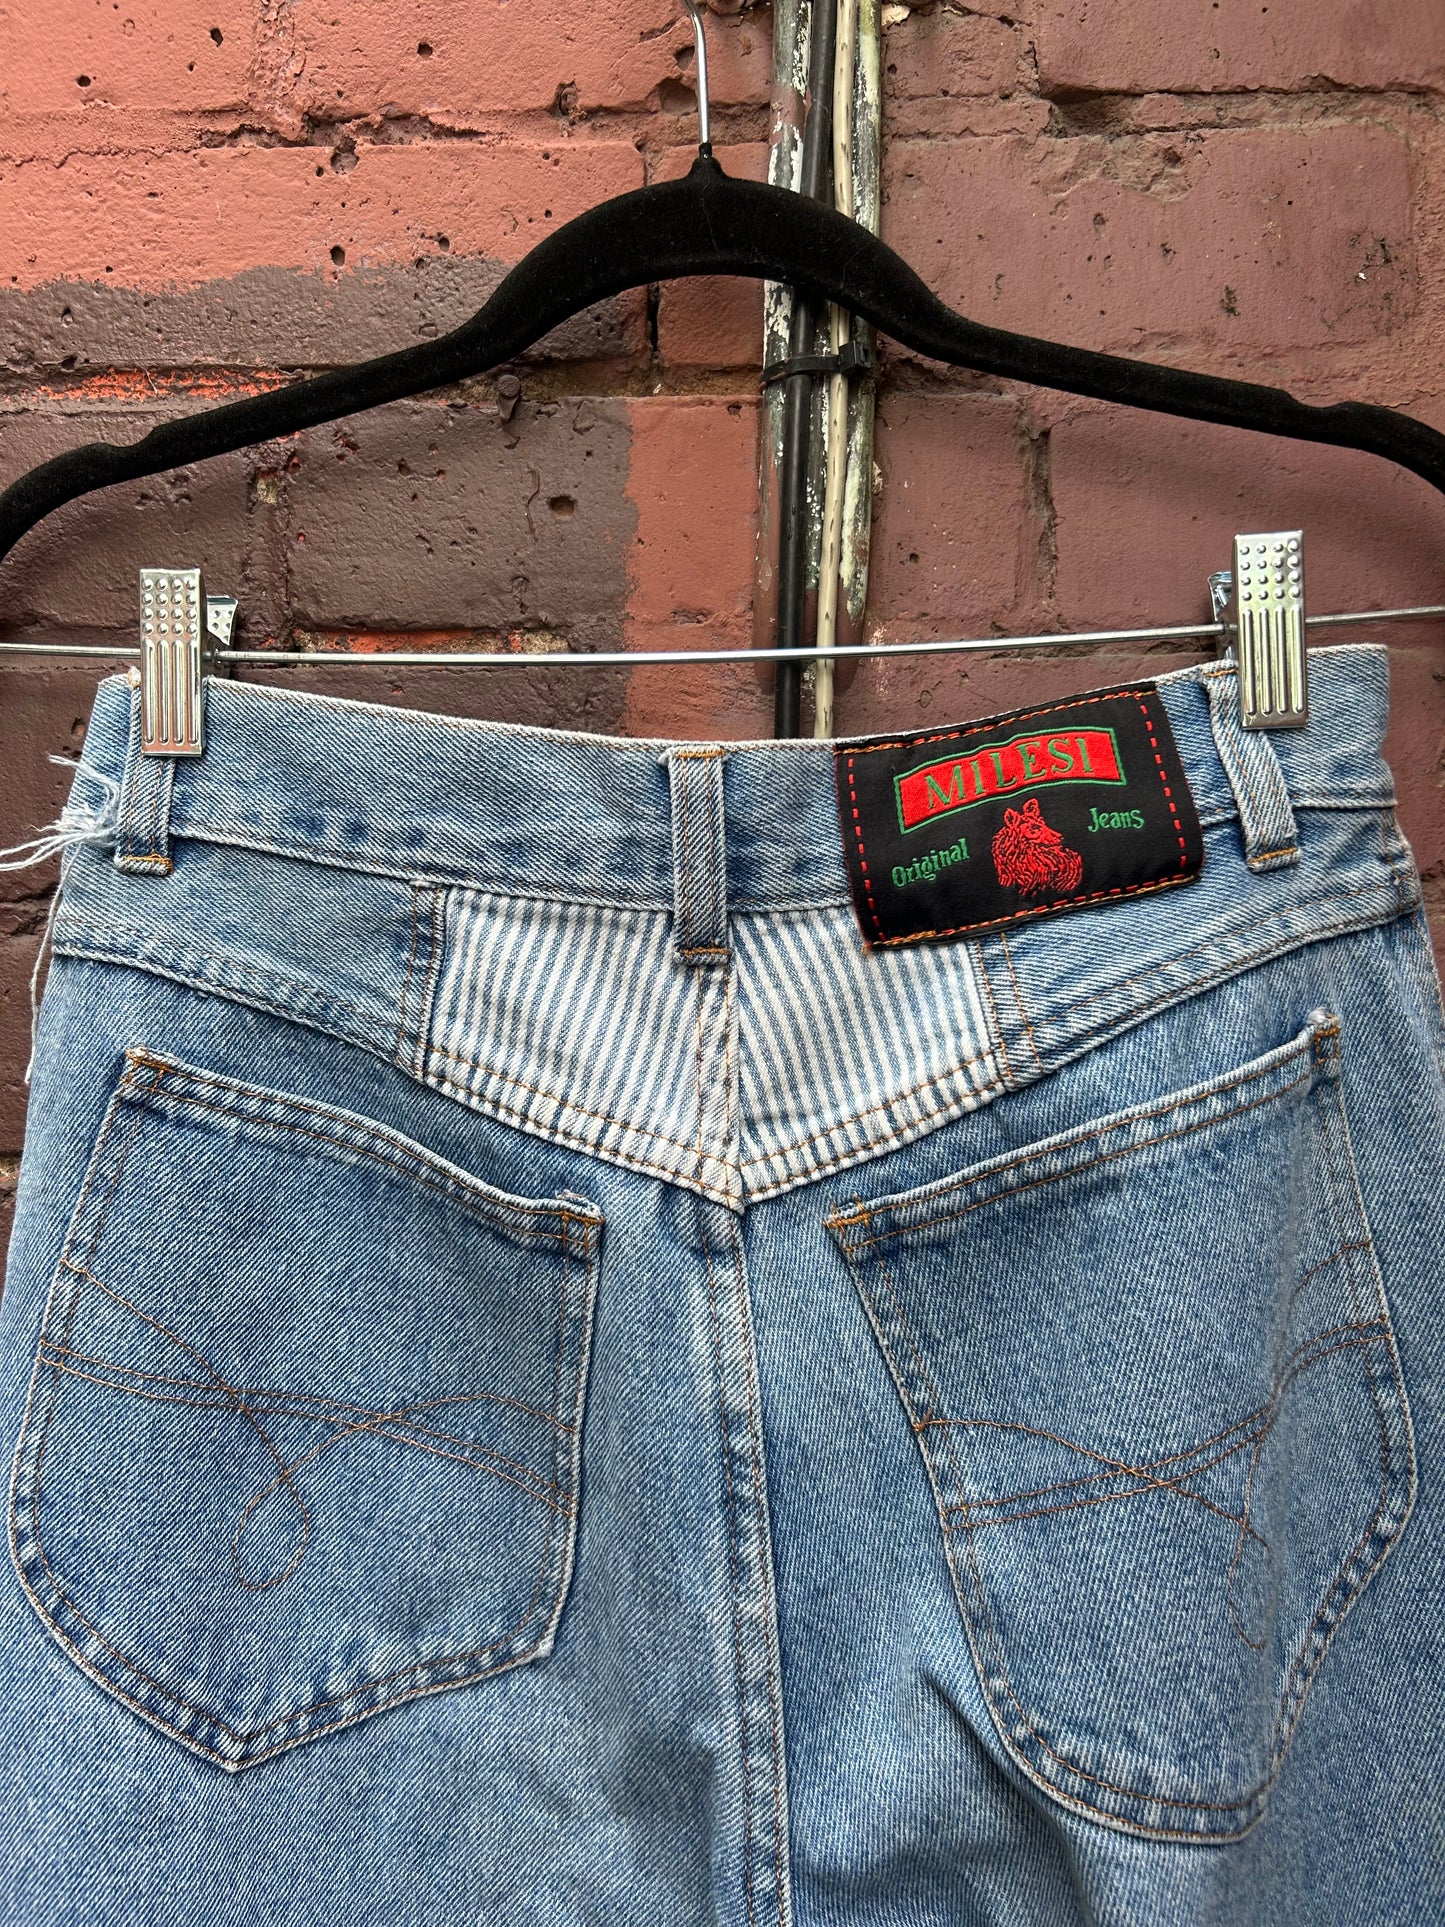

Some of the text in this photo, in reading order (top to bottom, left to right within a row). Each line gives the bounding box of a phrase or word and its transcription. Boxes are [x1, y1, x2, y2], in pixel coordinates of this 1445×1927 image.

[925, 738, 1094, 810] MILESI
[891, 807, 1145, 888] Original Jeans
